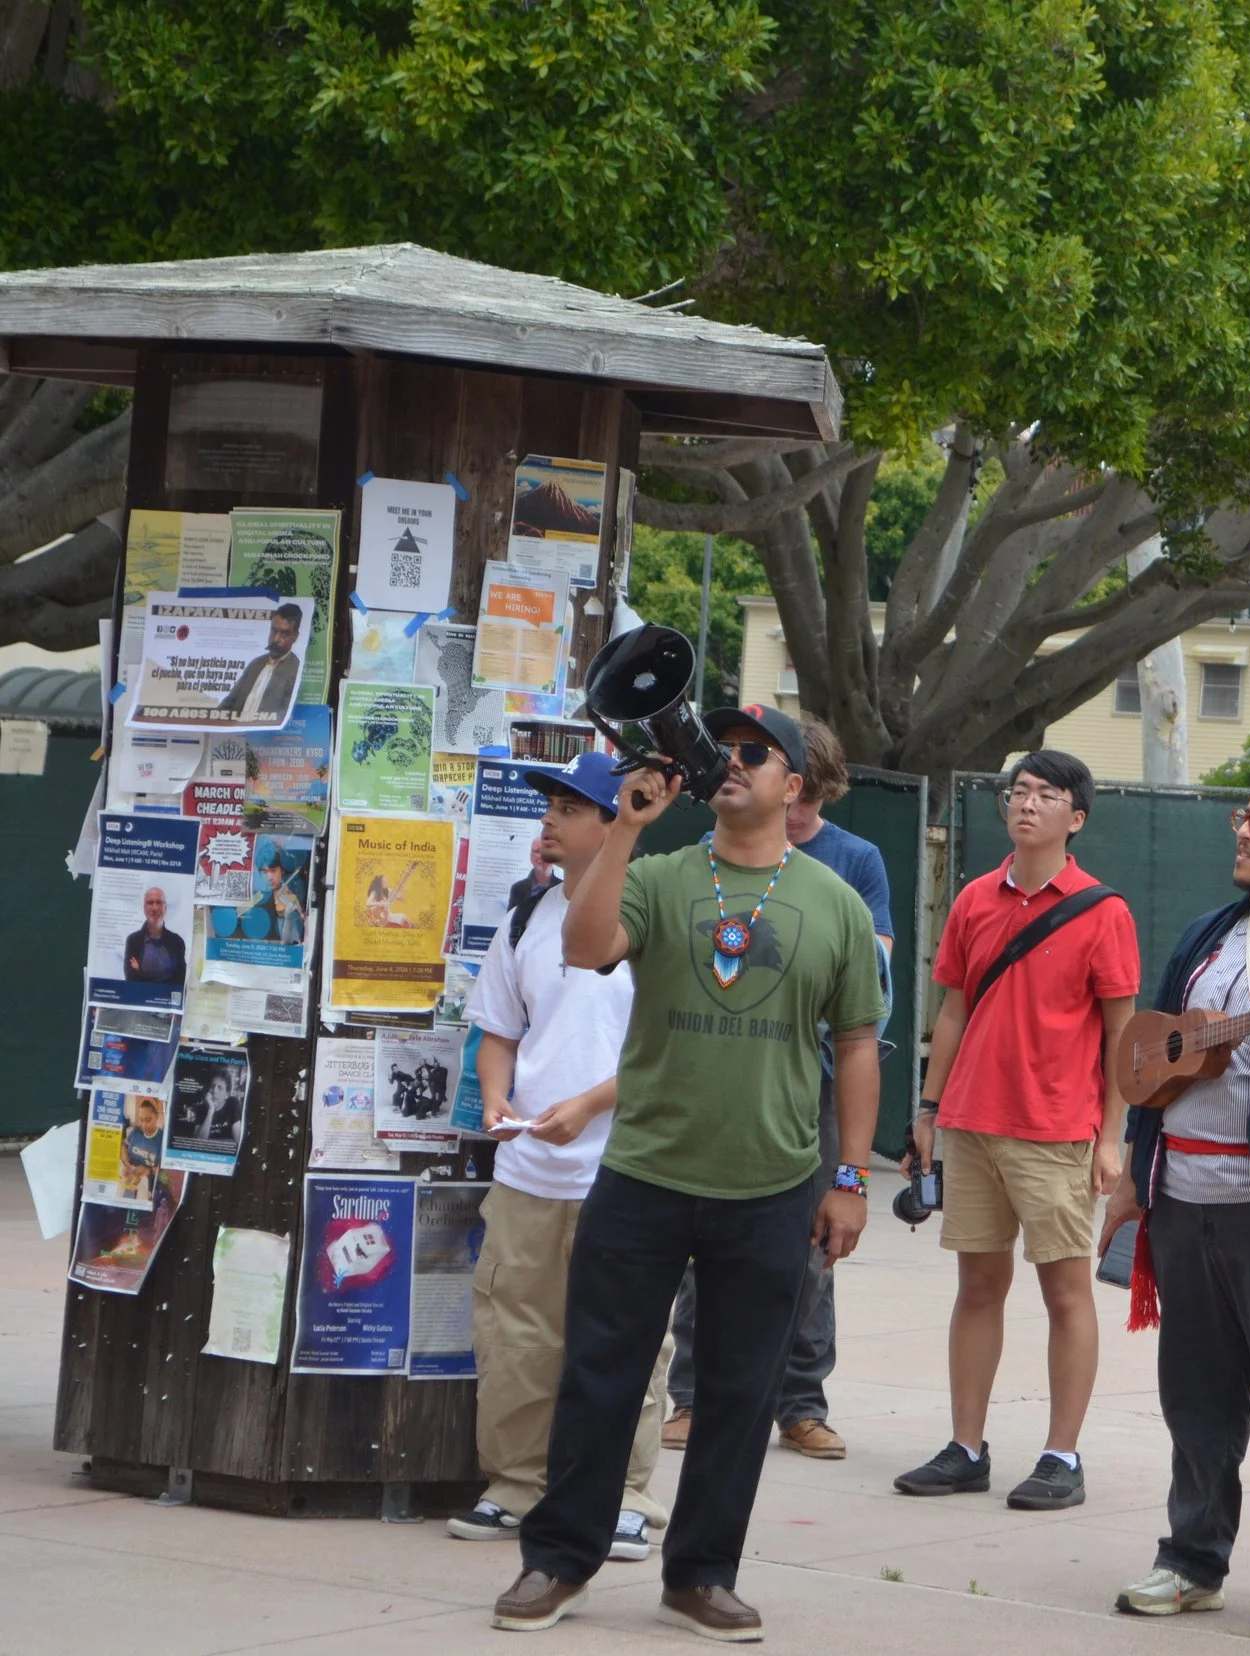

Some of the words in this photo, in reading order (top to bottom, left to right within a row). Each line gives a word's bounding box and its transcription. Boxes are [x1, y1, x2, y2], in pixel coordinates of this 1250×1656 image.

[489, 591, 503, 599] WE
[506, 592, 521, 601] ARE
[505, 603, 541, 614] HIRING!
[178, 658, 187, 667] no
[187, 656, 199, 669] hay
[199, 656, 226, 669] justicia
[227, 659, 245, 669] para
[183, 671, 196, 681] que
[197, 671, 205, 680] no
[205, 669, 223, 681] haya
[224, 672, 237, 682] paz
[176, 681, 192, 692] para
[143, 707, 168, 717] 100
[168, 706, 208, 720] AÑOS
[209, 709, 230, 720] DE
[457, 760, 476, 770] STOR
[432, 772, 466, 783] MAPACHE
[194, 786, 231, 799] MARCH
[234, 787, 245, 800] ON
[482, 783, 502, 794] Deep
[480, 802, 494, 810] Mon,
[105, 836, 121, 846] Deep
[153, 840, 185, 851] Workshop
[358, 838, 394, 850] Music
[397, 839, 408, 851] of
[410, 841, 436, 853] India
[668, 1010, 714, 1035] UNION
[718, 1015, 742, 1037] DEL
[324, 1060, 369, 1070] JITTERBUG
[332, 1194, 390, 1221] Sardines
